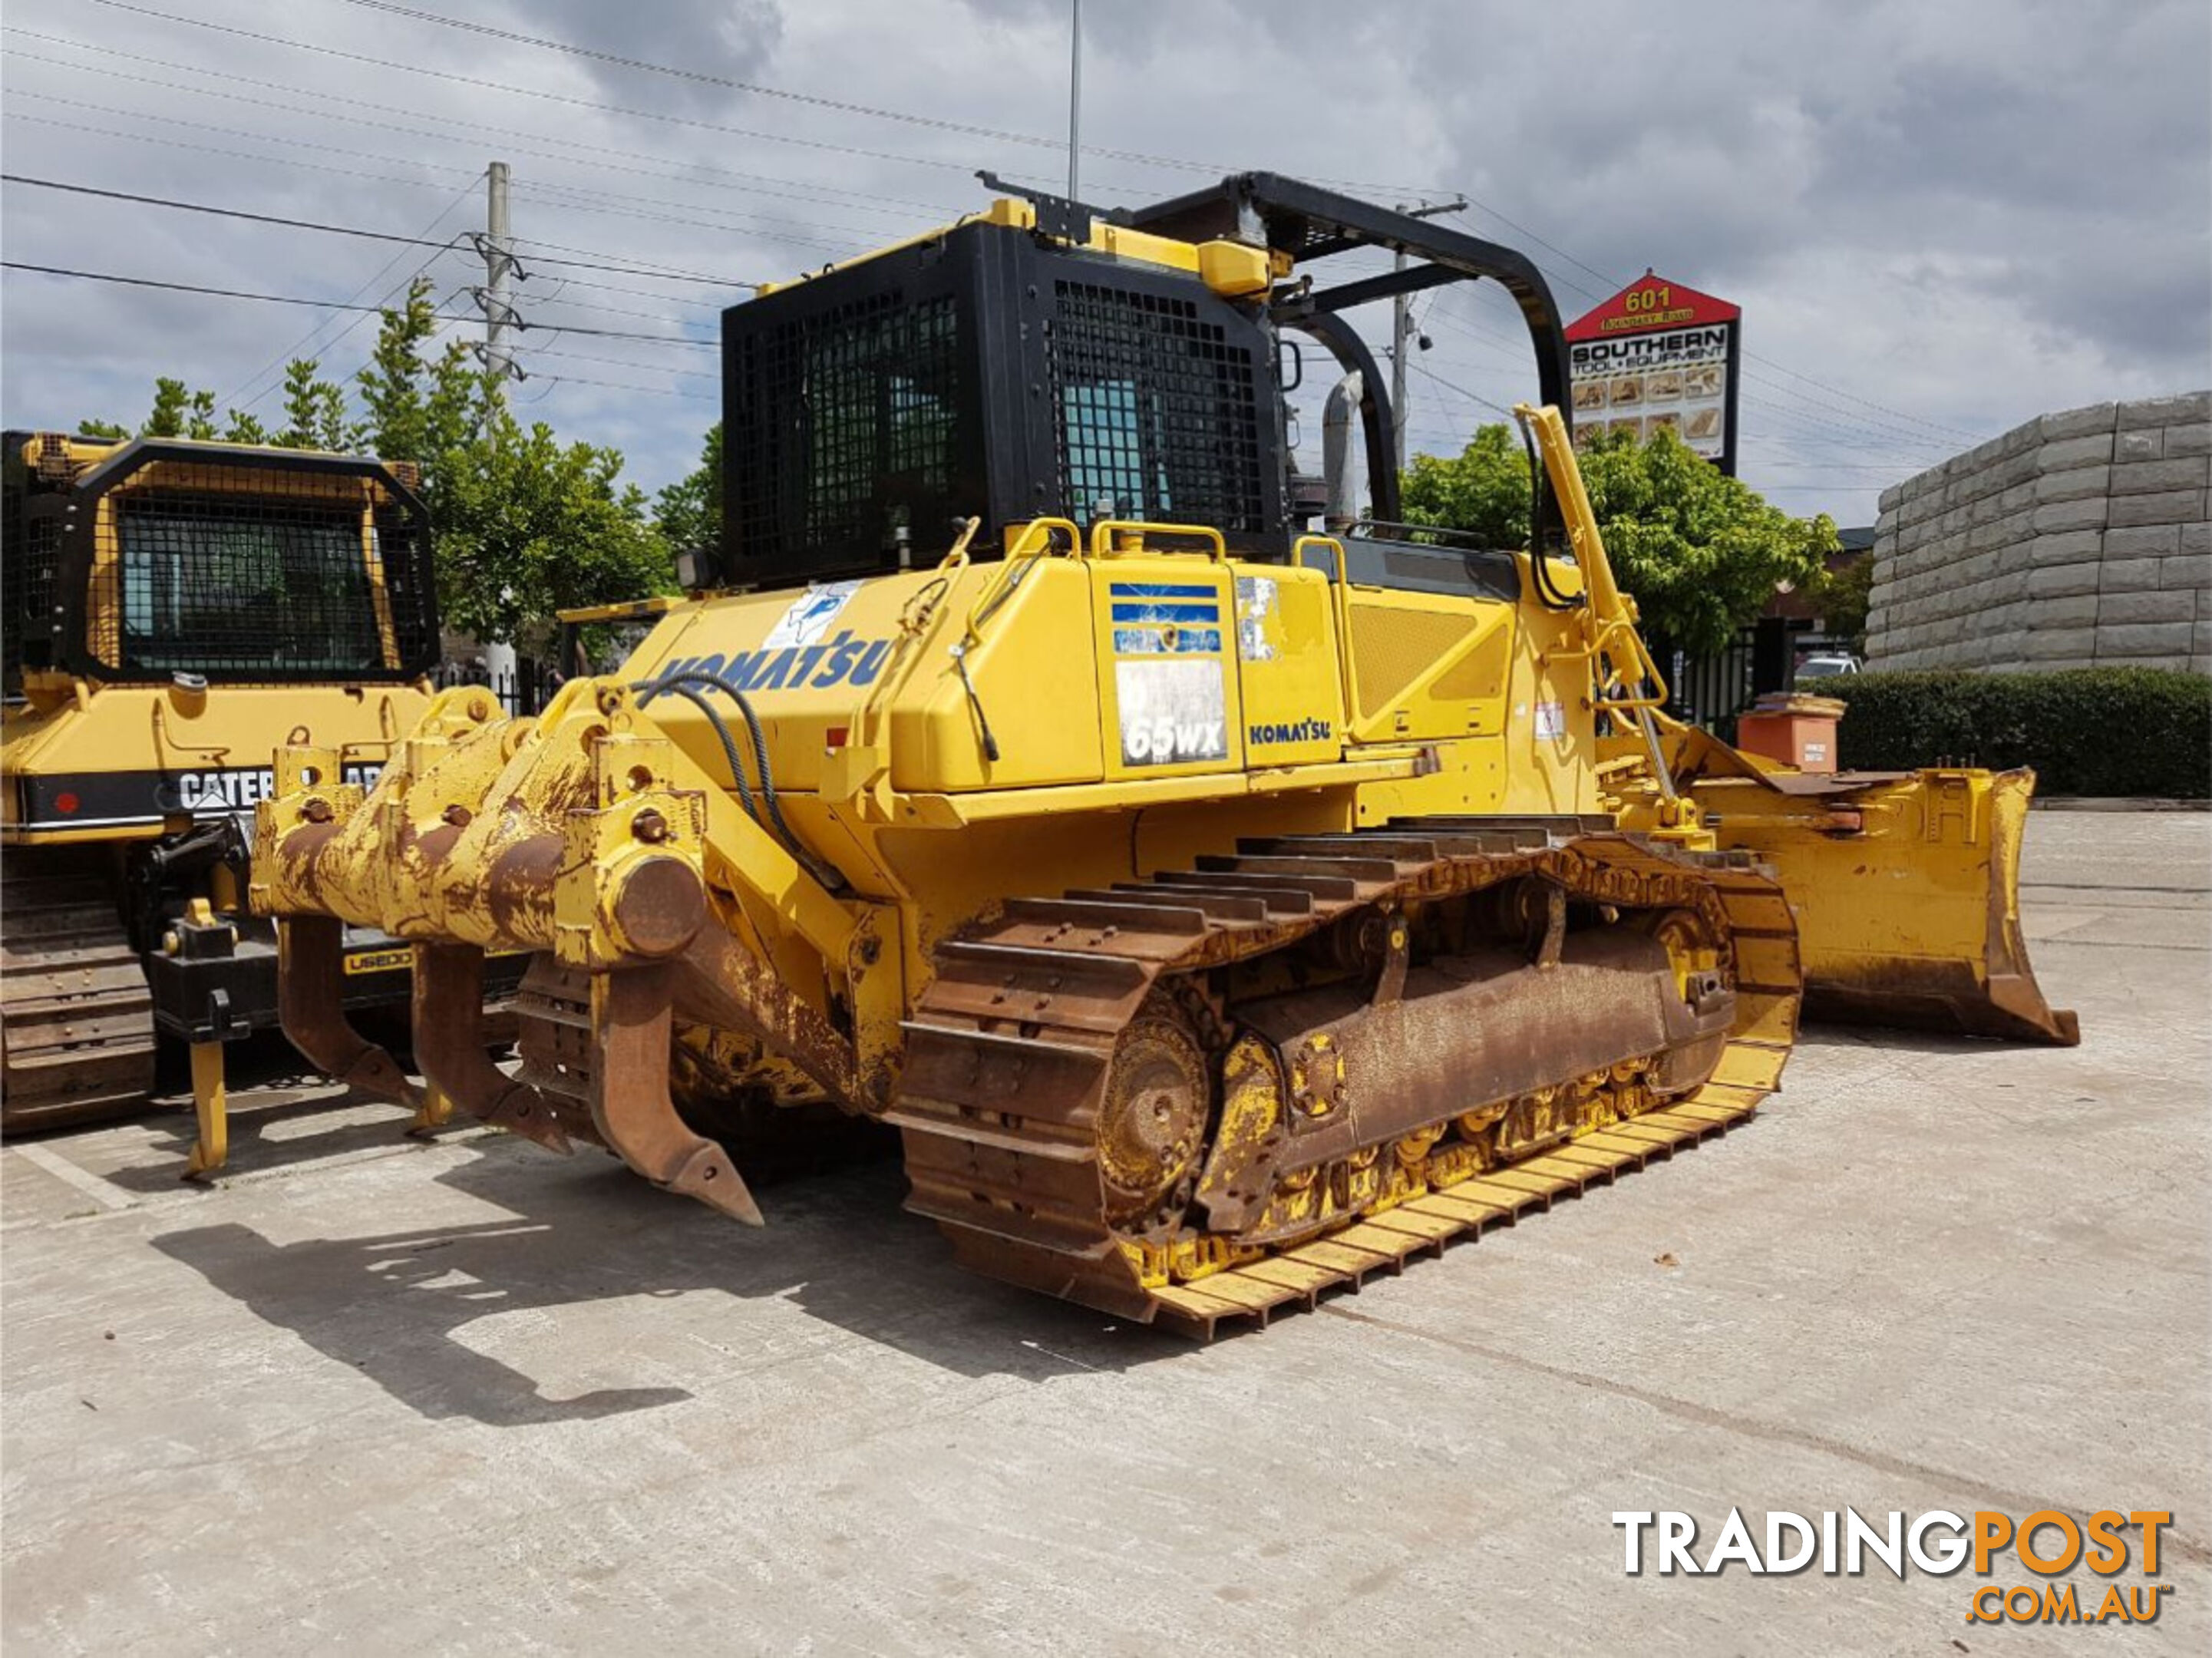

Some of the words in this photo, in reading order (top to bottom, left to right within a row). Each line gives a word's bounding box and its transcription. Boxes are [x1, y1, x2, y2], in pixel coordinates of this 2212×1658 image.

[1626, 286, 1670, 312] 601
[1573, 329, 1725, 363] SOUTHERN
[1573, 360, 1616, 375] TOOL
[1626, 345, 1724, 368] EQUIPMENT
[657, 629, 895, 697] KOMATSU
[1249, 717, 1330, 745] KOMATSU
